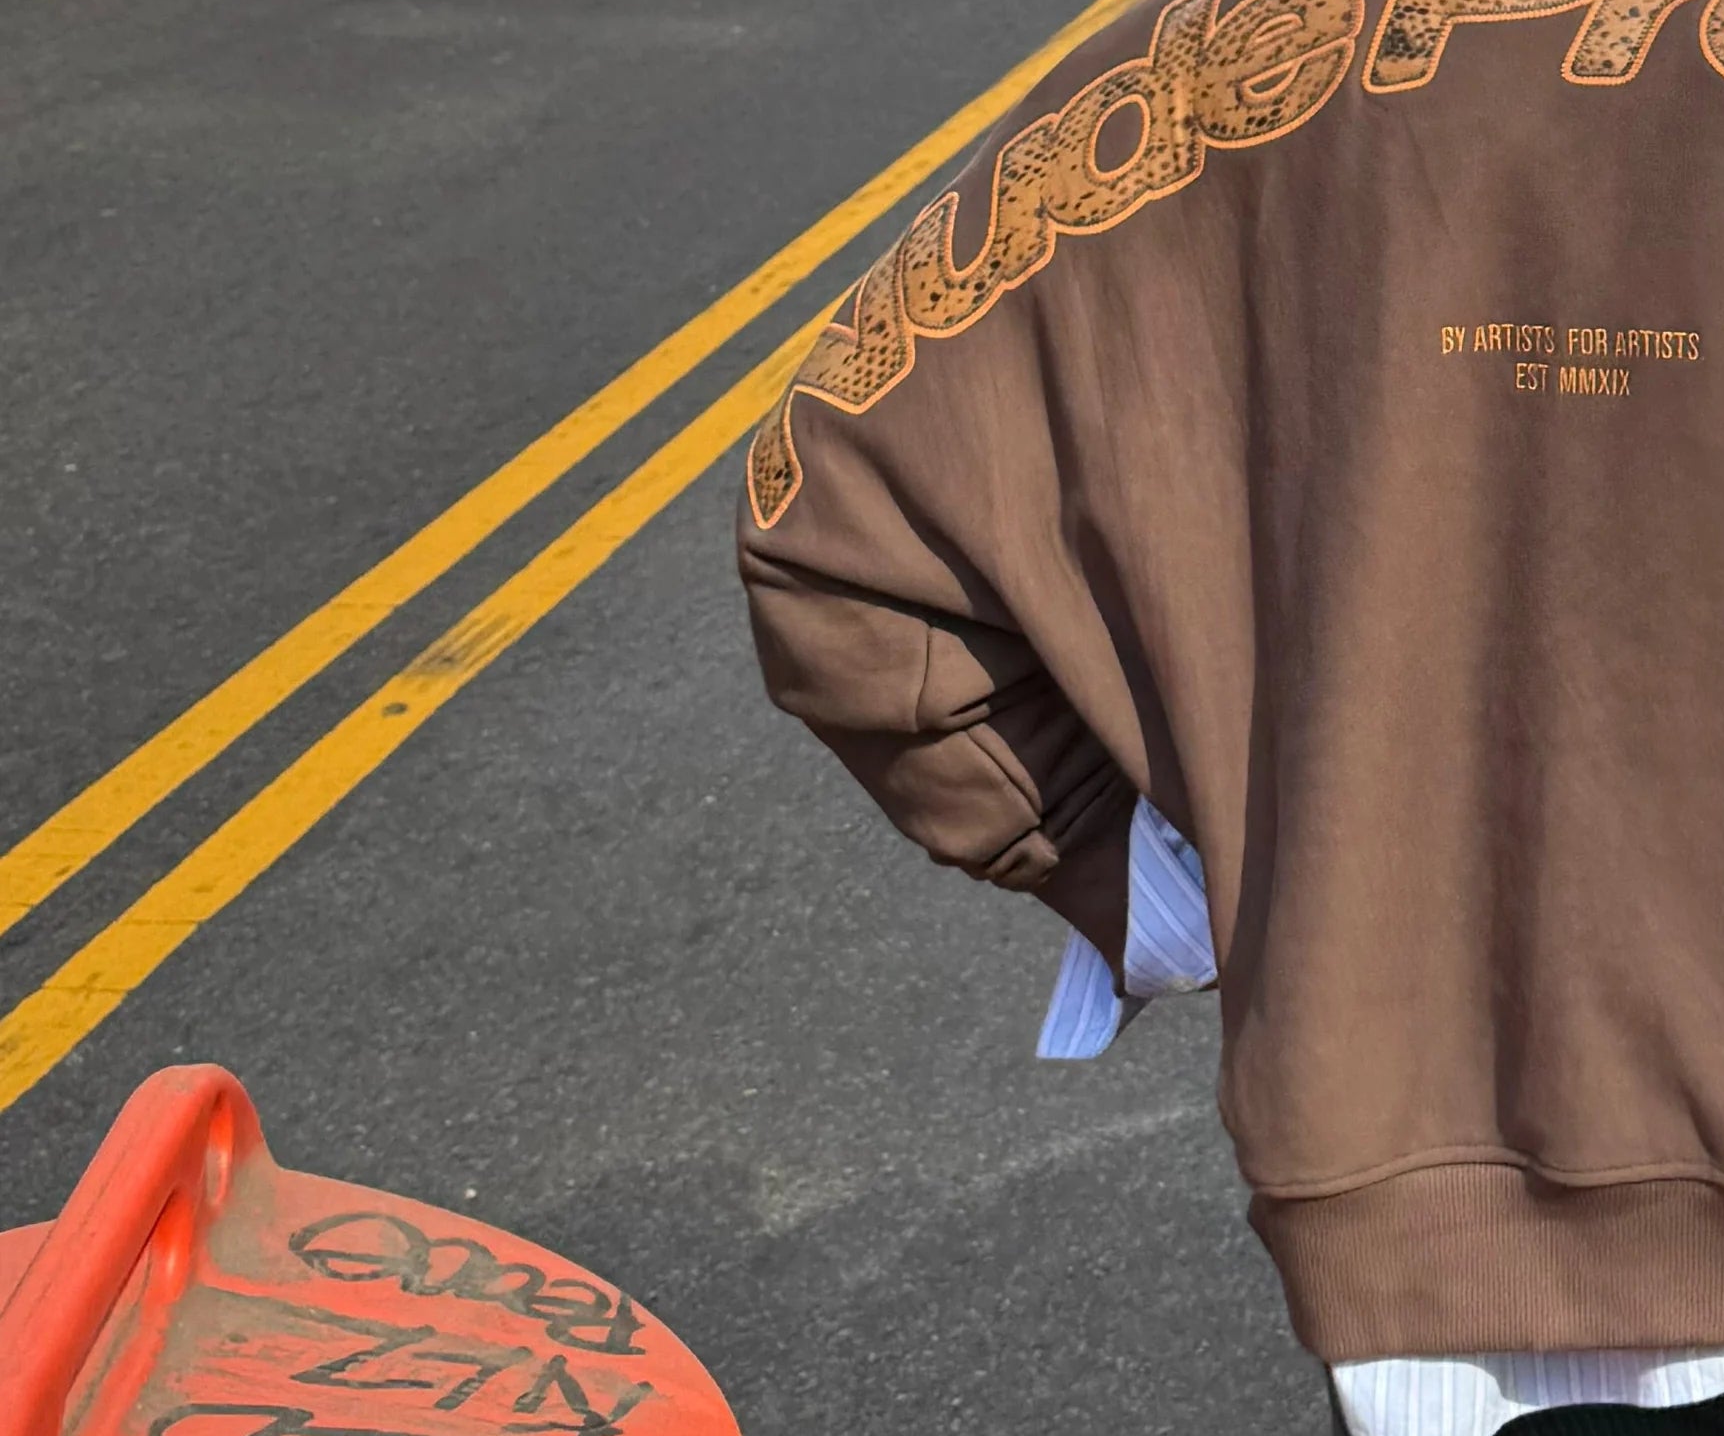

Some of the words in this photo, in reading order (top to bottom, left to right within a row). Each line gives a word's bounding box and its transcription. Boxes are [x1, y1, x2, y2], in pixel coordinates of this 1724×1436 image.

[1441, 326, 1466, 354] BY
[1473, 323, 1556, 353] ARTISTS
[1568, 328, 1608, 357] FOR
[1615, 329, 1701, 361] ARTISTS
[1515, 363, 1549, 392] EST
[1559, 366, 1631, 396] MMXIX
